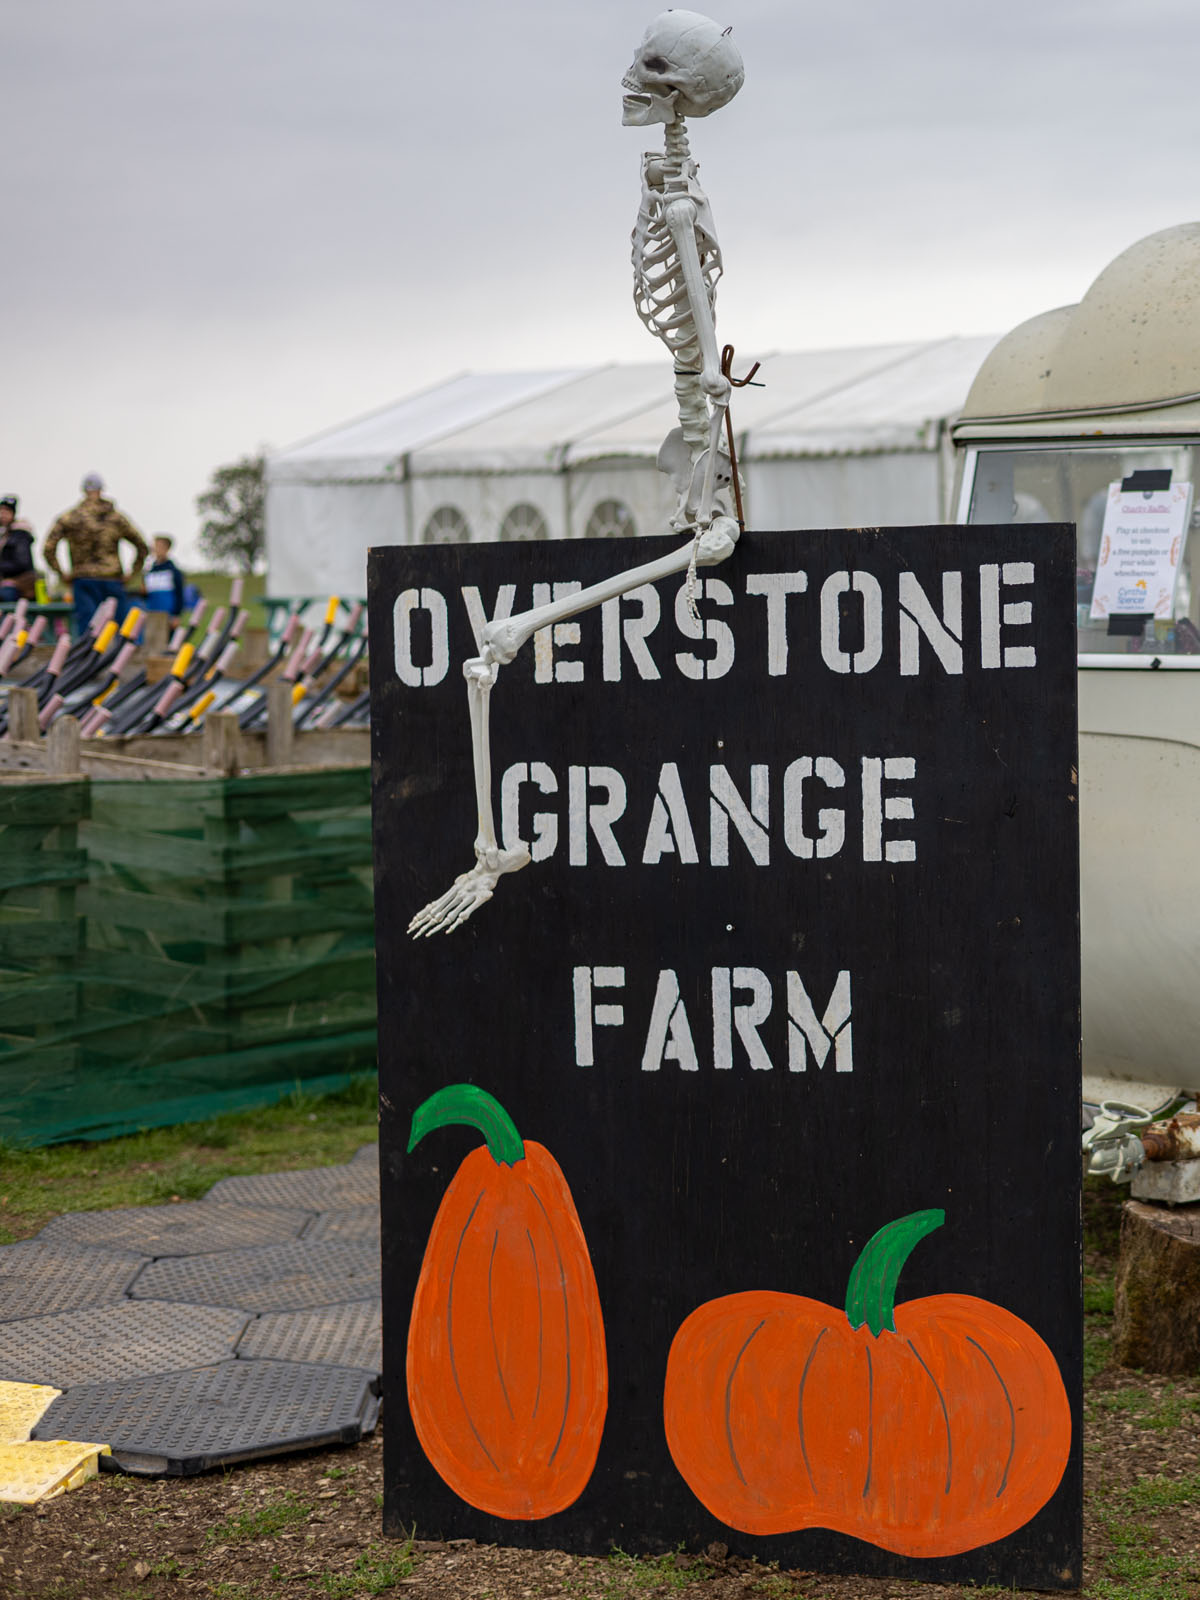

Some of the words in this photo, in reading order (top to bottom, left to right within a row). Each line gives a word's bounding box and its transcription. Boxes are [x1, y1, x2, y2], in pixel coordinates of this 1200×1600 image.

[1131, 548, 1160, 556] pumpkin
[393, 562, 1036, 687] OVERSTONE
[502, 756, 916, 866] GRANGE
[573, 965, 853, 1072] FARM
